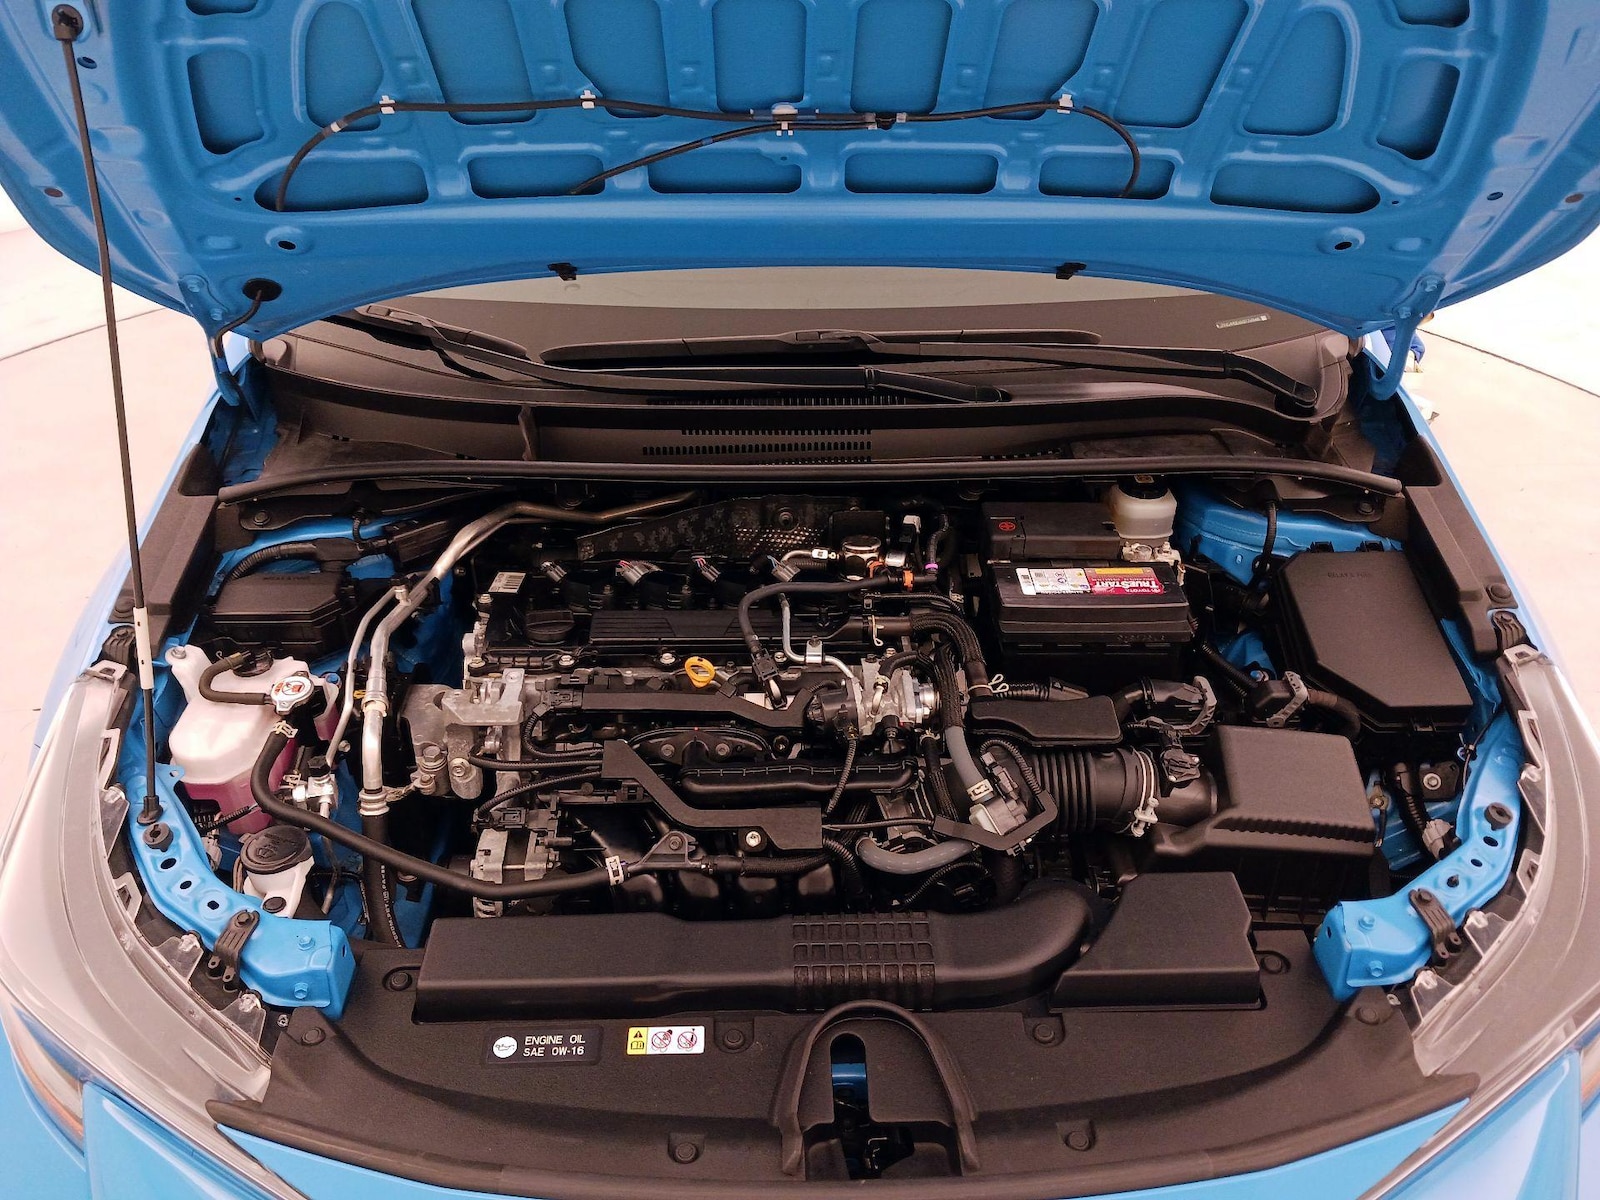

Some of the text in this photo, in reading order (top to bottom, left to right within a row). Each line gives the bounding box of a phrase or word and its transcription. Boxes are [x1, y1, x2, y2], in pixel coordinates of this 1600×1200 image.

[524, 1034, 586, 1046] ENGINE OIL
[522, 1046, 585, 1057] SAE 0W-16
